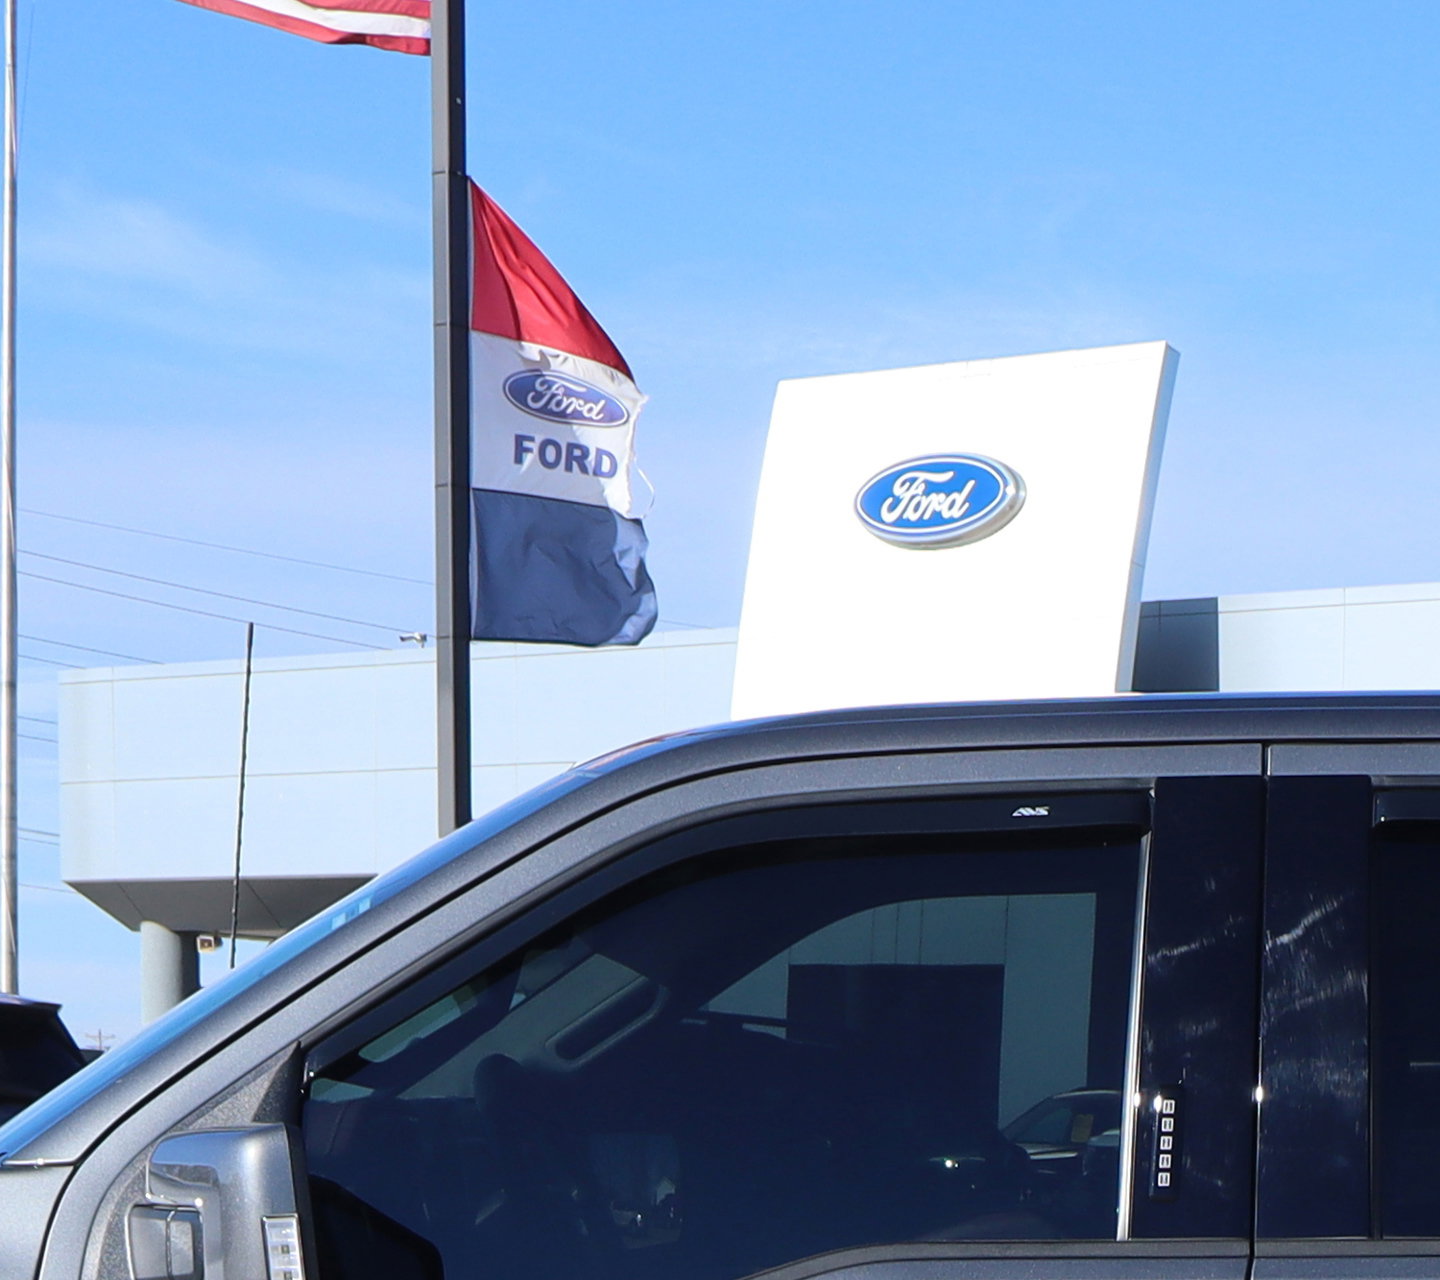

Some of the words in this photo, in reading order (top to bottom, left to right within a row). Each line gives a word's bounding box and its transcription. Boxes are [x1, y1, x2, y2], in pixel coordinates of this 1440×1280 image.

[527, 374, 605, 422] Ford
[513, 434, 618, 480] FORD
[880, 470, 976, 524] Ford
